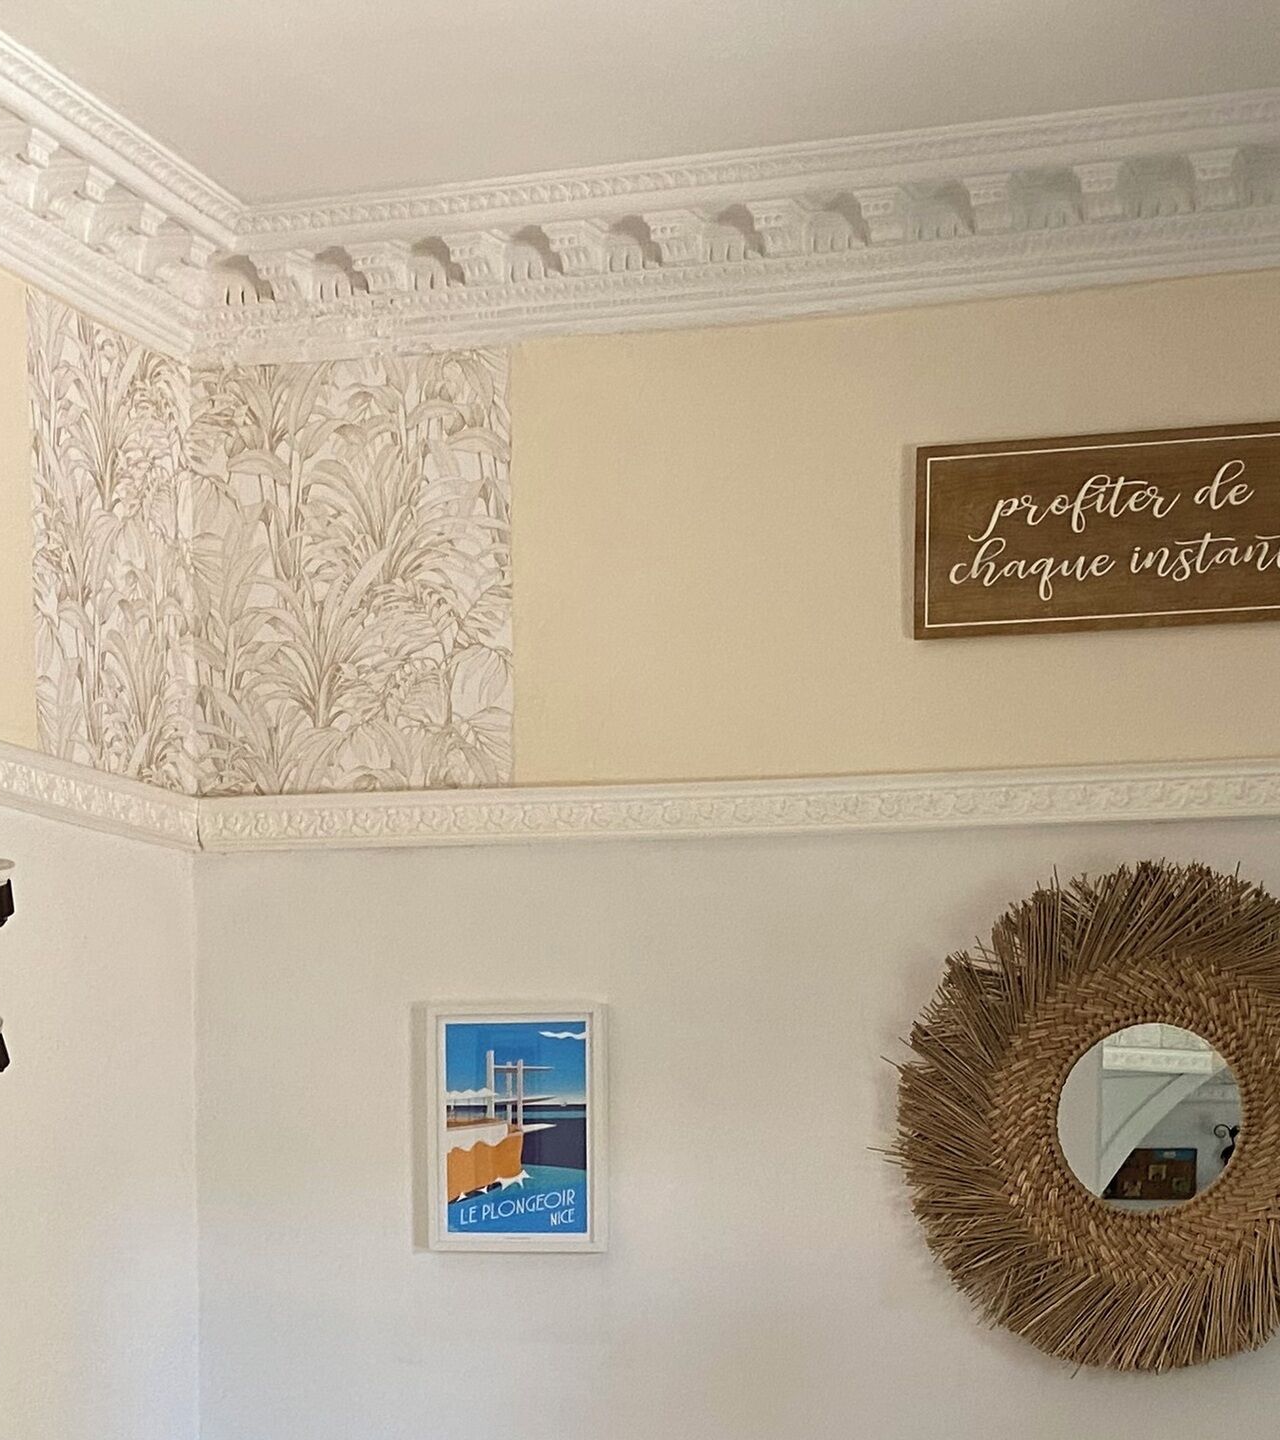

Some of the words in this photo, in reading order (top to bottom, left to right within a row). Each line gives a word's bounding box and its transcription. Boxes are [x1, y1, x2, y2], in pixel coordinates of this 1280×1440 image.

[968, 475, 1180, 541] profiter
[1193, 460, 1255, 511] de
[949, 537, 1116, 600] chaque
[460, 1206, 477, 1225] LE
[482, 1188, 576, 1220] PLONGEOIR
[550, 1208, 575, 1226] NICE
